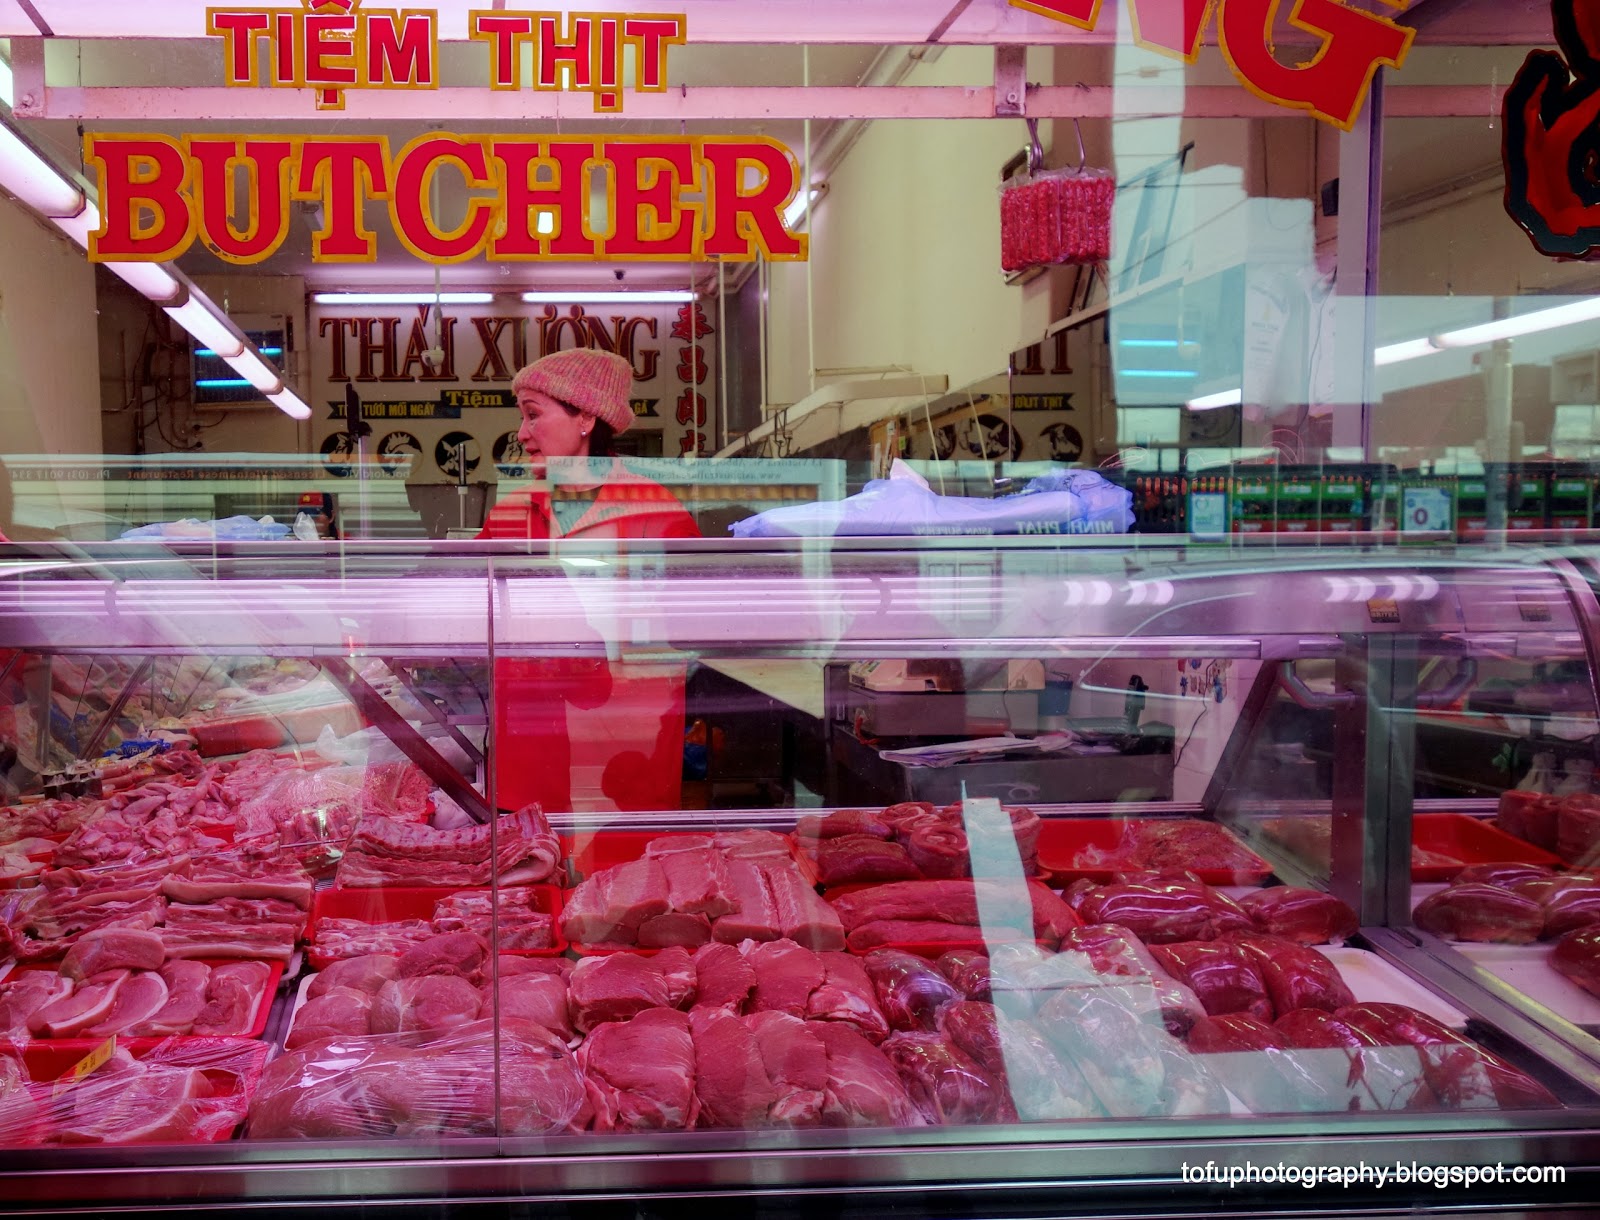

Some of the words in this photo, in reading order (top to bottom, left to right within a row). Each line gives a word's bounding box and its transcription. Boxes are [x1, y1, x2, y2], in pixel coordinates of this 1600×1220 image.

[206, 0, 438, 110] TIỆM
[469, 7, 686, 112] THỊT
[85, 131, 808, 264] BUTCHER
[319, 304, 458, 382] THÁI
[446, 390, 503, 407] Tiệm
